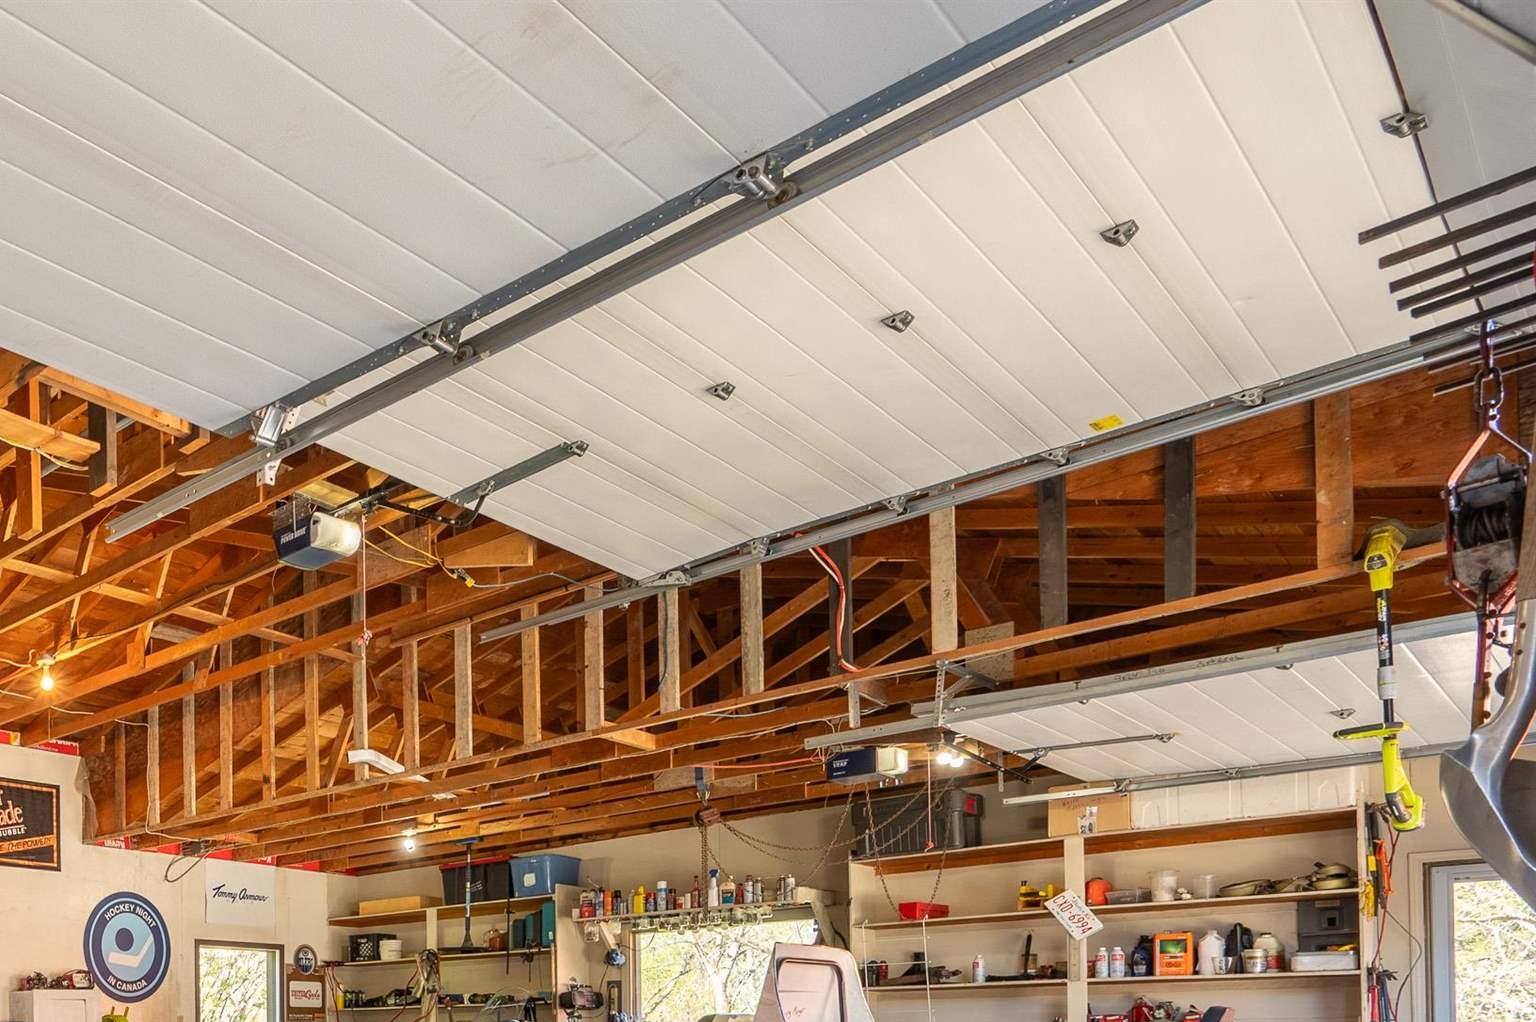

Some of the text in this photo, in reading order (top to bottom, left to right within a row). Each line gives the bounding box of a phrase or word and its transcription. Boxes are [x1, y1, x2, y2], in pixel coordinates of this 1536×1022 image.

[212, 883, 238, 904] Tommy
[105, 903, 157, 928] HOCKEY NIGHT
[1052, 895, 1093, 935] CXD-6994
[107, 975, 148, 992] IN CANADA
